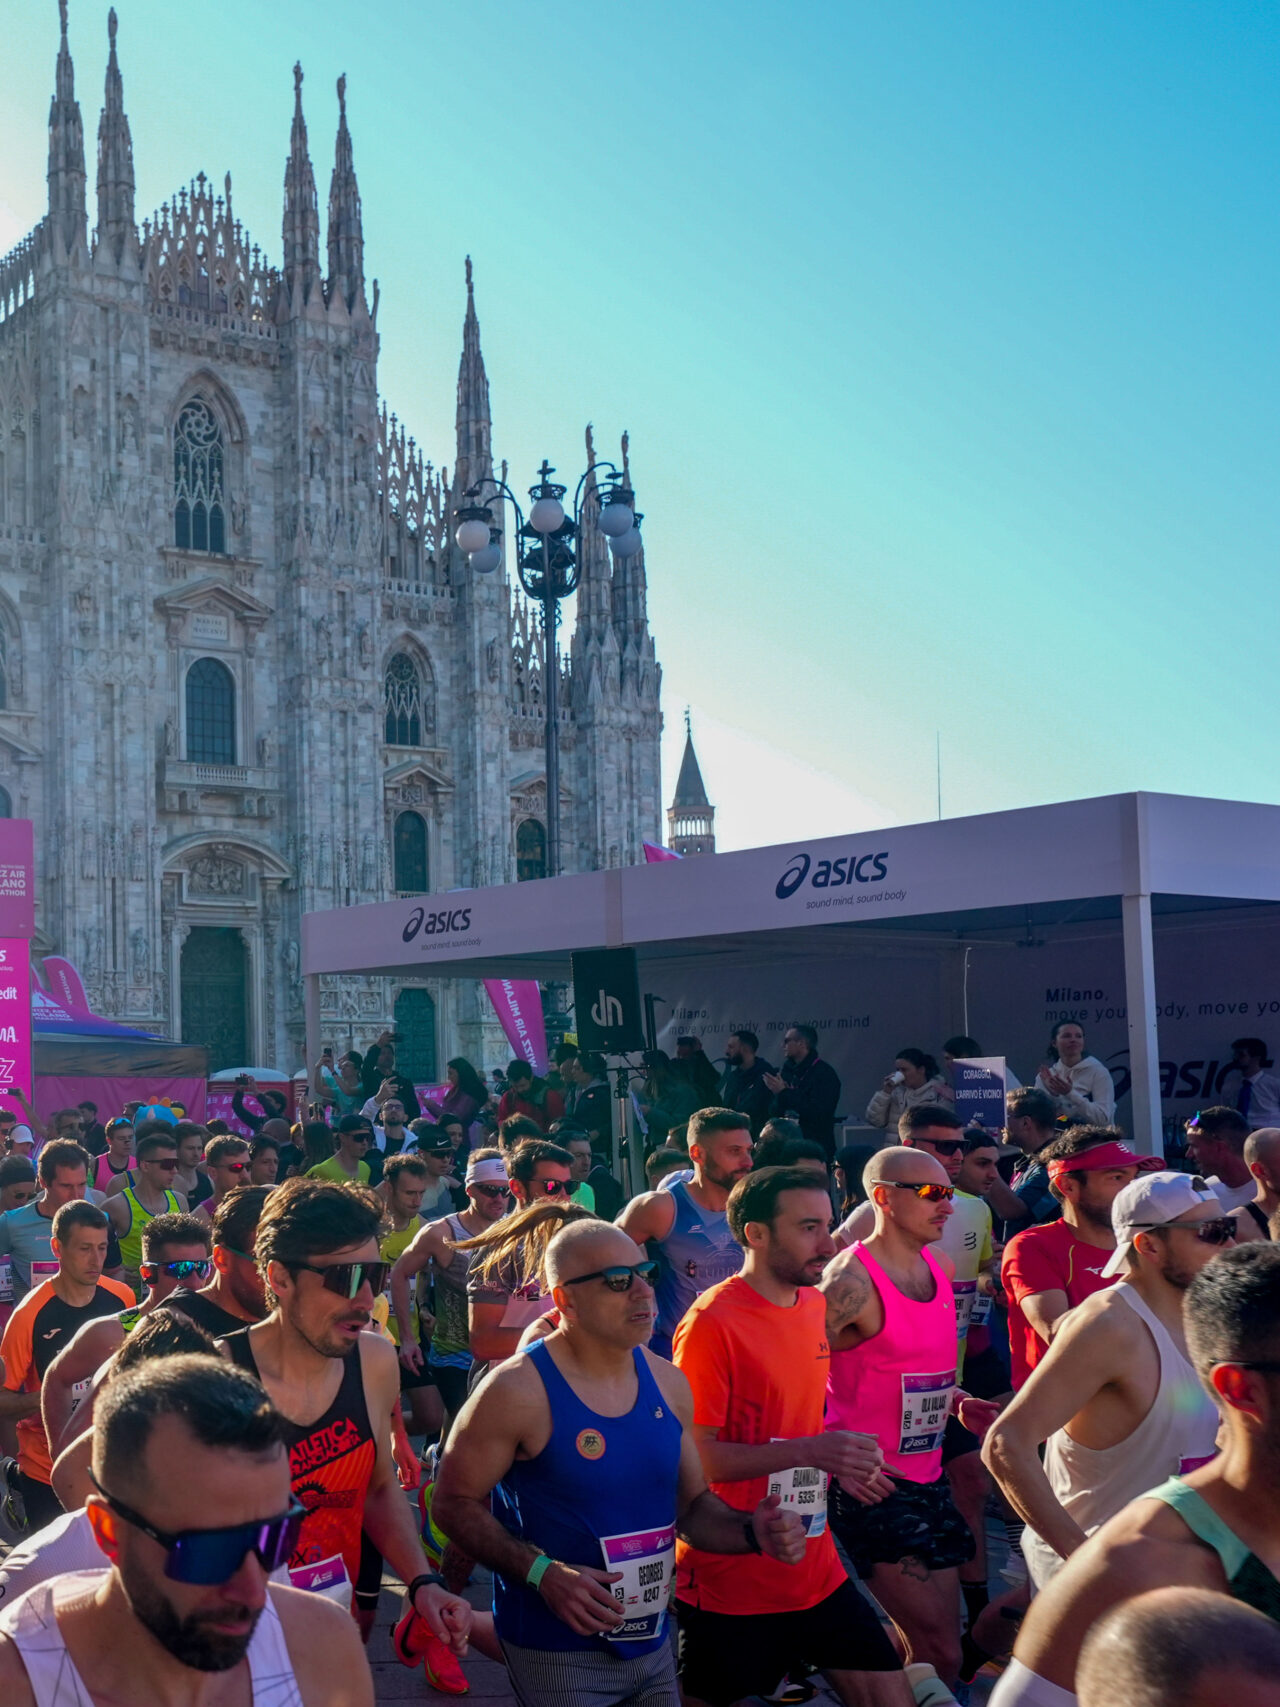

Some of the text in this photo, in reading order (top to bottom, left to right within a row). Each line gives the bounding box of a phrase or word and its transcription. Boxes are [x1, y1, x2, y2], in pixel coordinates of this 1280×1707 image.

[9, 869, 26, 879] AIR
[811, 852, 889, 889] asics
[806, 889, 907, 910] sound mind, sound body
[424, 907, 472, 935] asics
[1045, 987, 1109, 1003] Milano,
[1044, 1005, 1089, 1021] move
[1095, 1005, 1127, 1023] you
[1198, 1001, 1249, 1016] move
[729, 1019, 761, 1035] body,
[837, 1015, 870, 1029] mind
[963, 1068, 992, 1080] CORAGGIO,
[955, 1089, 978, 1100] L'ARRIVO
[983, 1088, 1003, 1099] VICINO!
[288, 1416, 359, 1467] ATLETICA
[638, 1561, 664, 1587] GEORGES
[643, 1586, 660, 1604] 4247
[623, 1620, 648, 1632] asics
